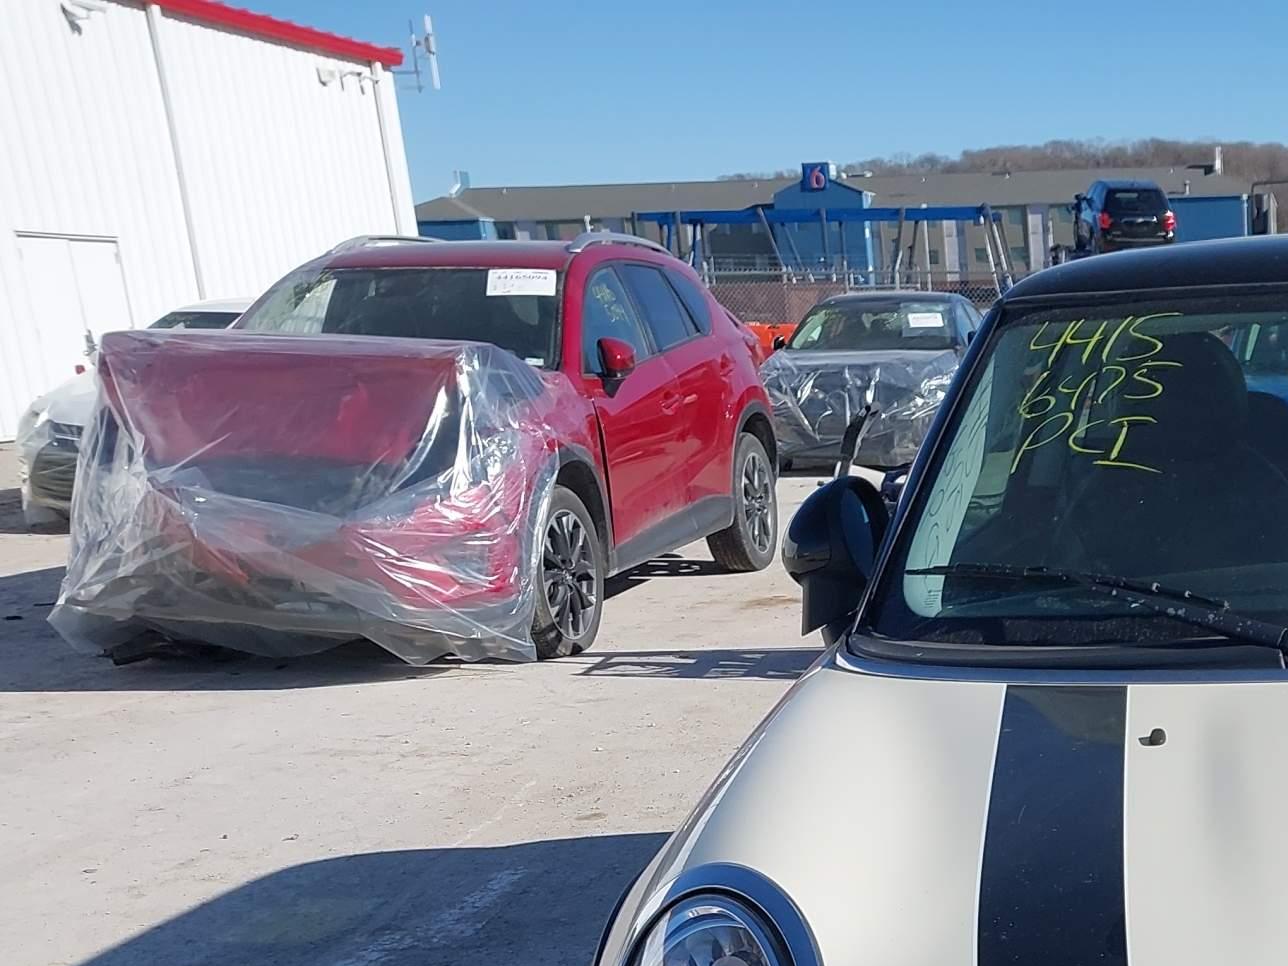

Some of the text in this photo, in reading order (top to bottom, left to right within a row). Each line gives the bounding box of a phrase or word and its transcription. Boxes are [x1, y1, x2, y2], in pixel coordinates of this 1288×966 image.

[810, 165, 826, 189] 6
[1029, 312, 1184, 368] 4415
[1018, 359, 1184, 418] 6475
